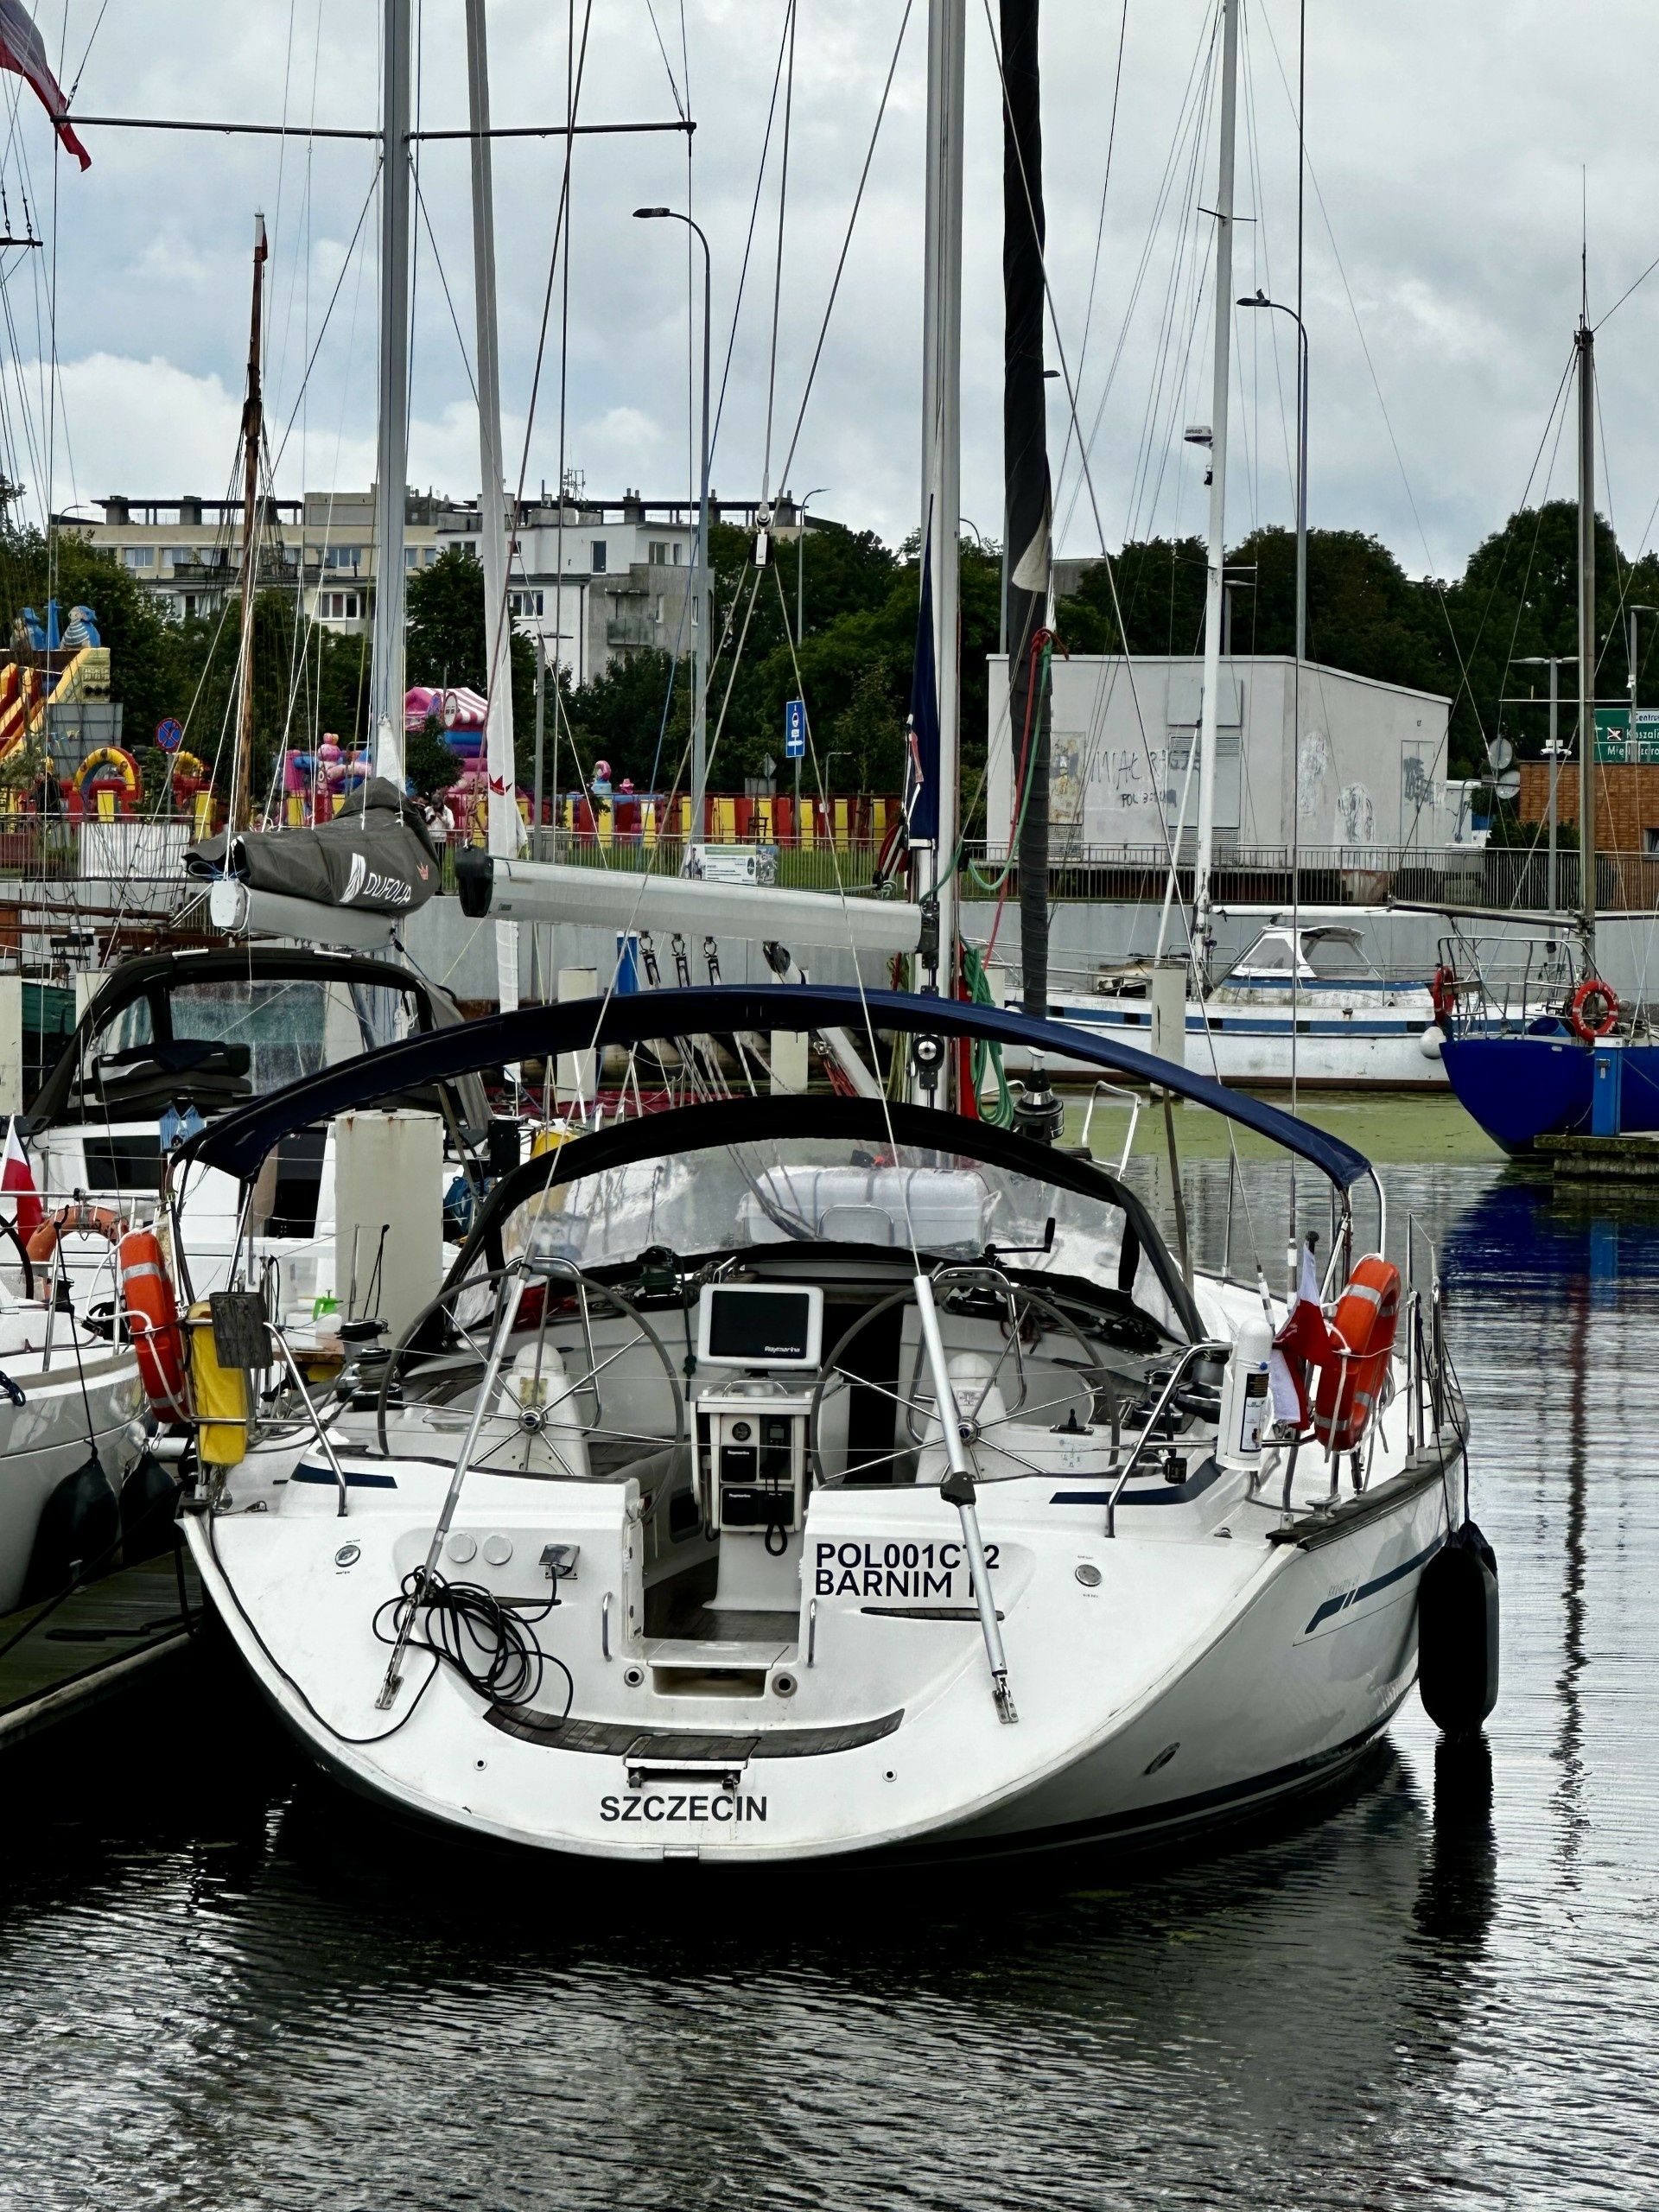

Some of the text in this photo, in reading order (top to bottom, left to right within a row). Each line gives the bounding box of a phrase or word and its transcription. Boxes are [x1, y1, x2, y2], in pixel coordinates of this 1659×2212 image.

[817, 1543, 1000, 1569] POL001C2
[815, 1569, 952, 1599] BARNIM
[600, 1796, 767, 1822] SZCZECIN
